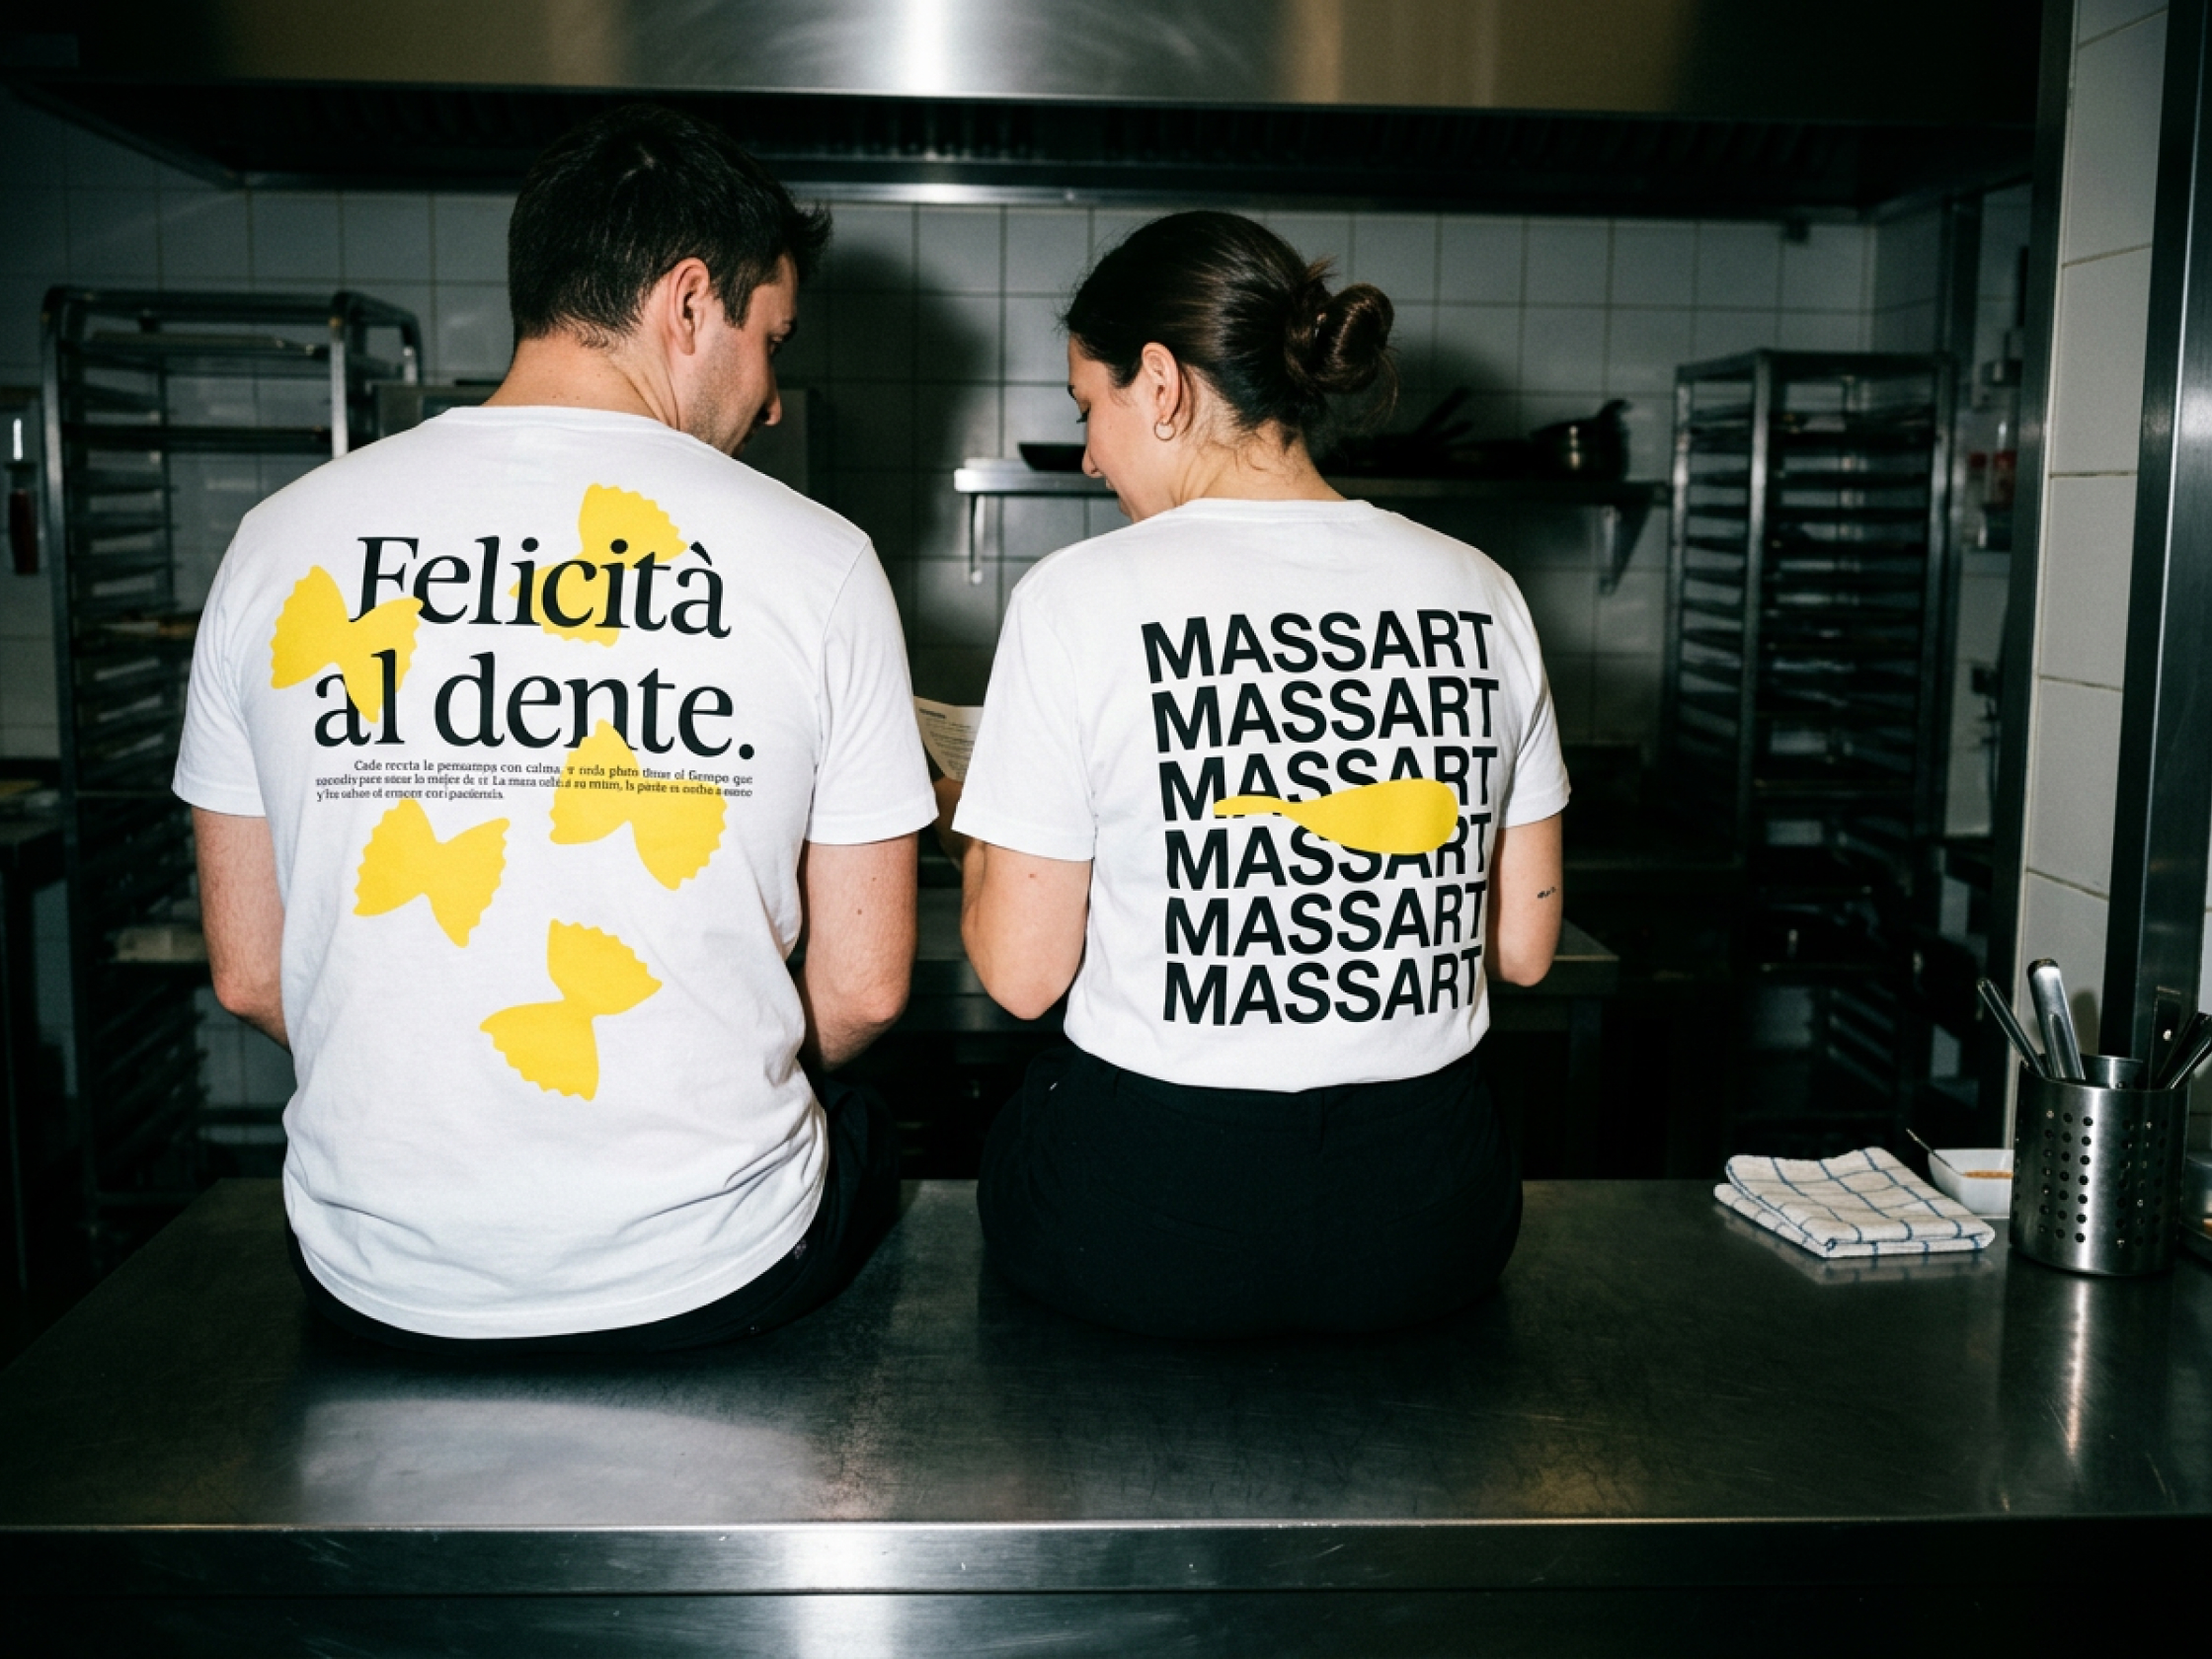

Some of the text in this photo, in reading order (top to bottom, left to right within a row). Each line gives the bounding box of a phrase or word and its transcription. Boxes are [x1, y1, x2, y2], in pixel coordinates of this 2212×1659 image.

[350, 536, 731, 638] Felicità
[1141, 608, 1494, 684] MASSART
[314, 649, 755, 760] al dente.
[1151, 675, 1500, 753] MASSART
[1164, 880, 1488, 957] MASSART
[1162, 943, 1483, 1026] MASSART
